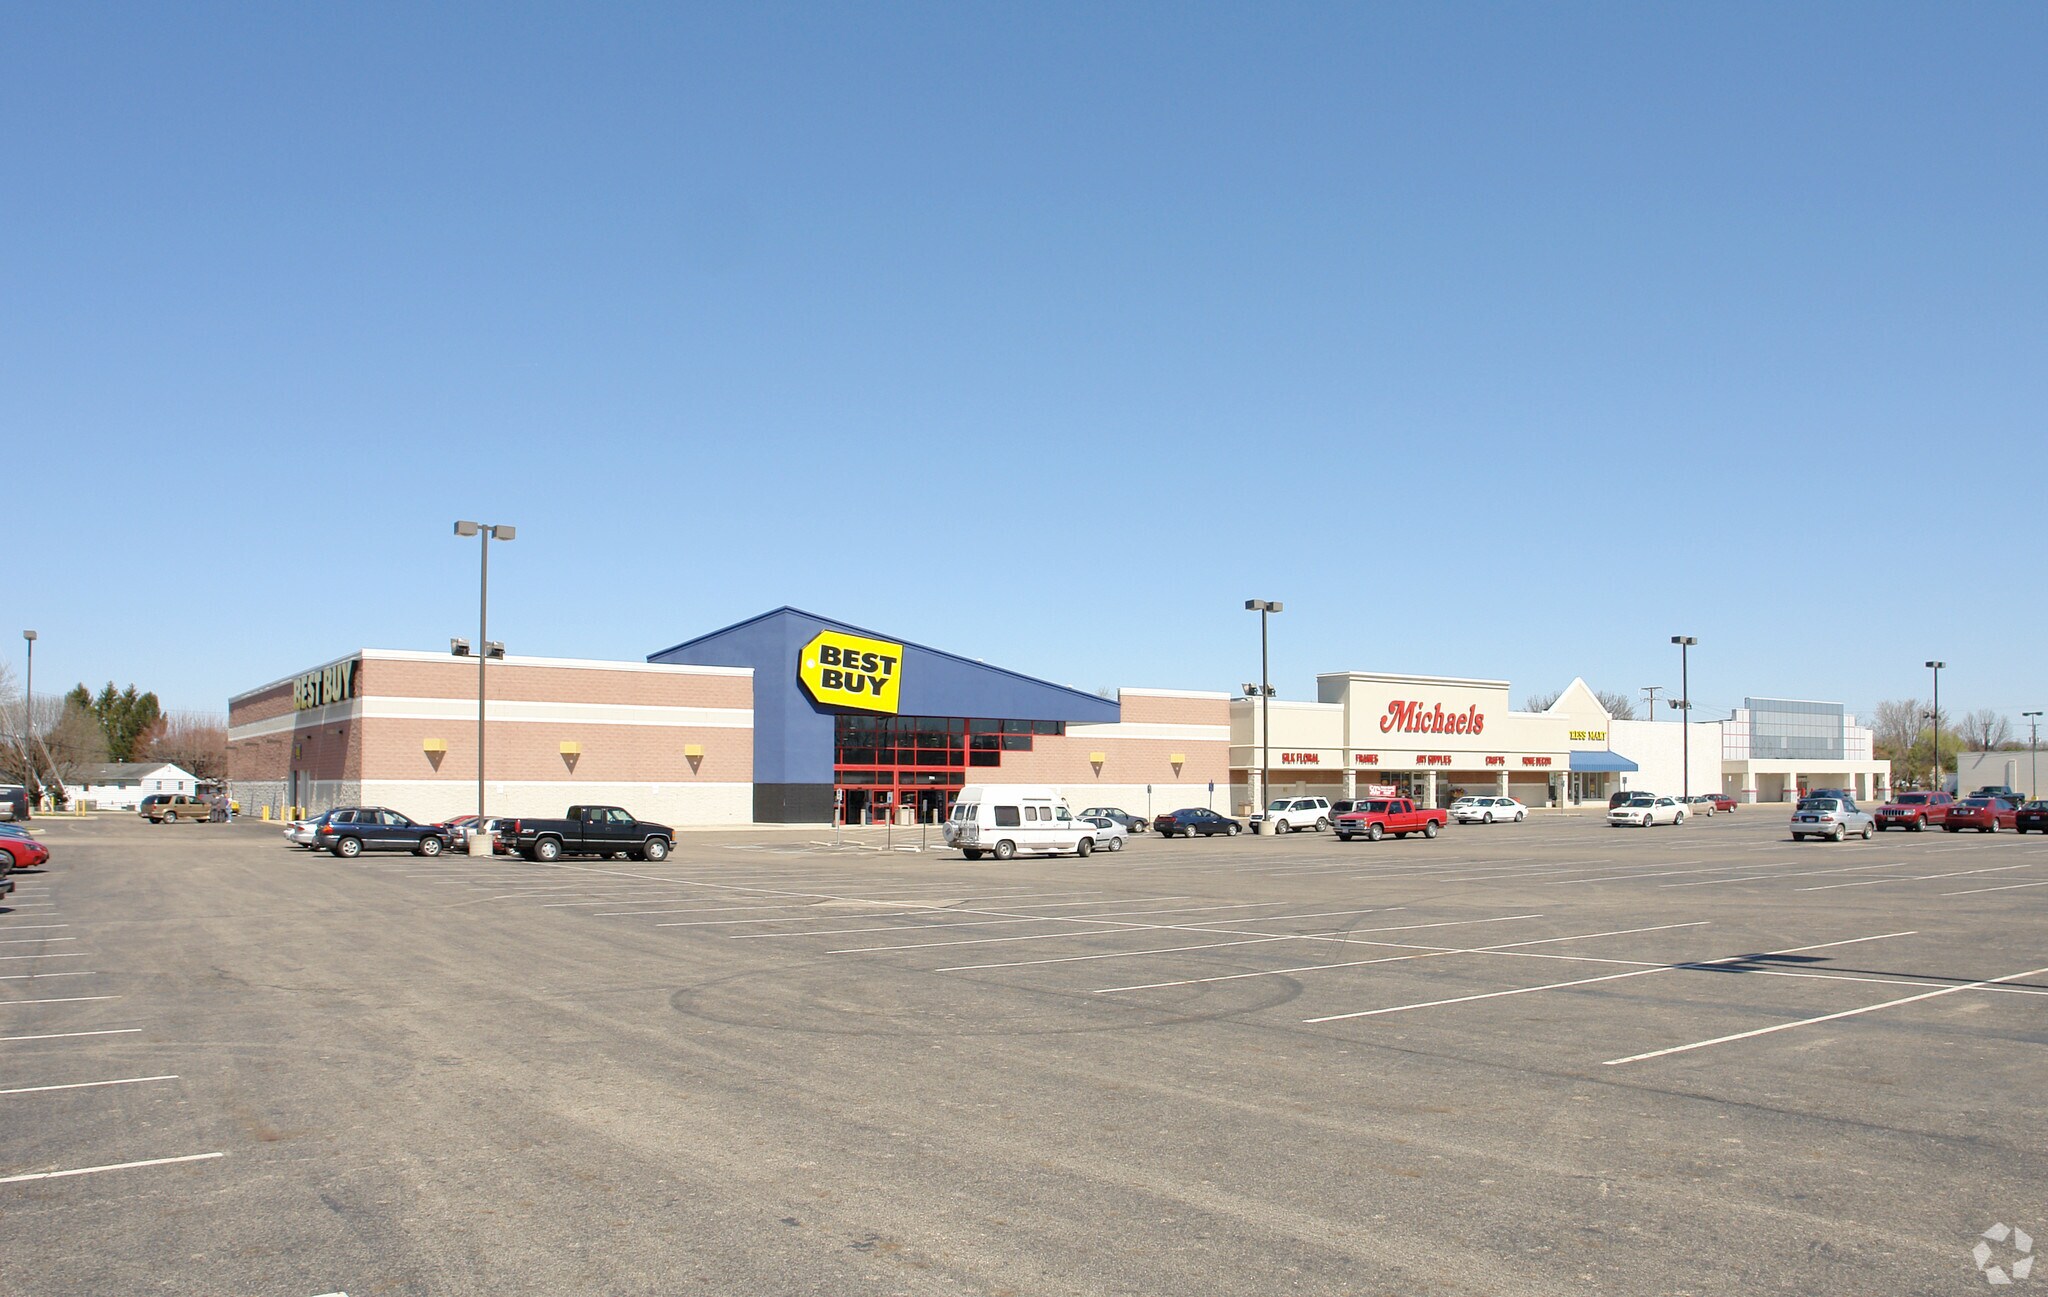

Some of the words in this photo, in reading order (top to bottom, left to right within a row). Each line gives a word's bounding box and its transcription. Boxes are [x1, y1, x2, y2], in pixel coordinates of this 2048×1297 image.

[820, 645, 897, 675] BEST
[293, 671, 322, 710] BEST
[323, 660, 353, 705] BUY
[821, 668, 889, 696] BUY
[1380, 700, 1484, 735] Michaels
[1281, 753, 1296, 763] SILK
[1296, 753, 1319, 764] FLORAL
[1355, 754, 1379, 764] FRAMES
